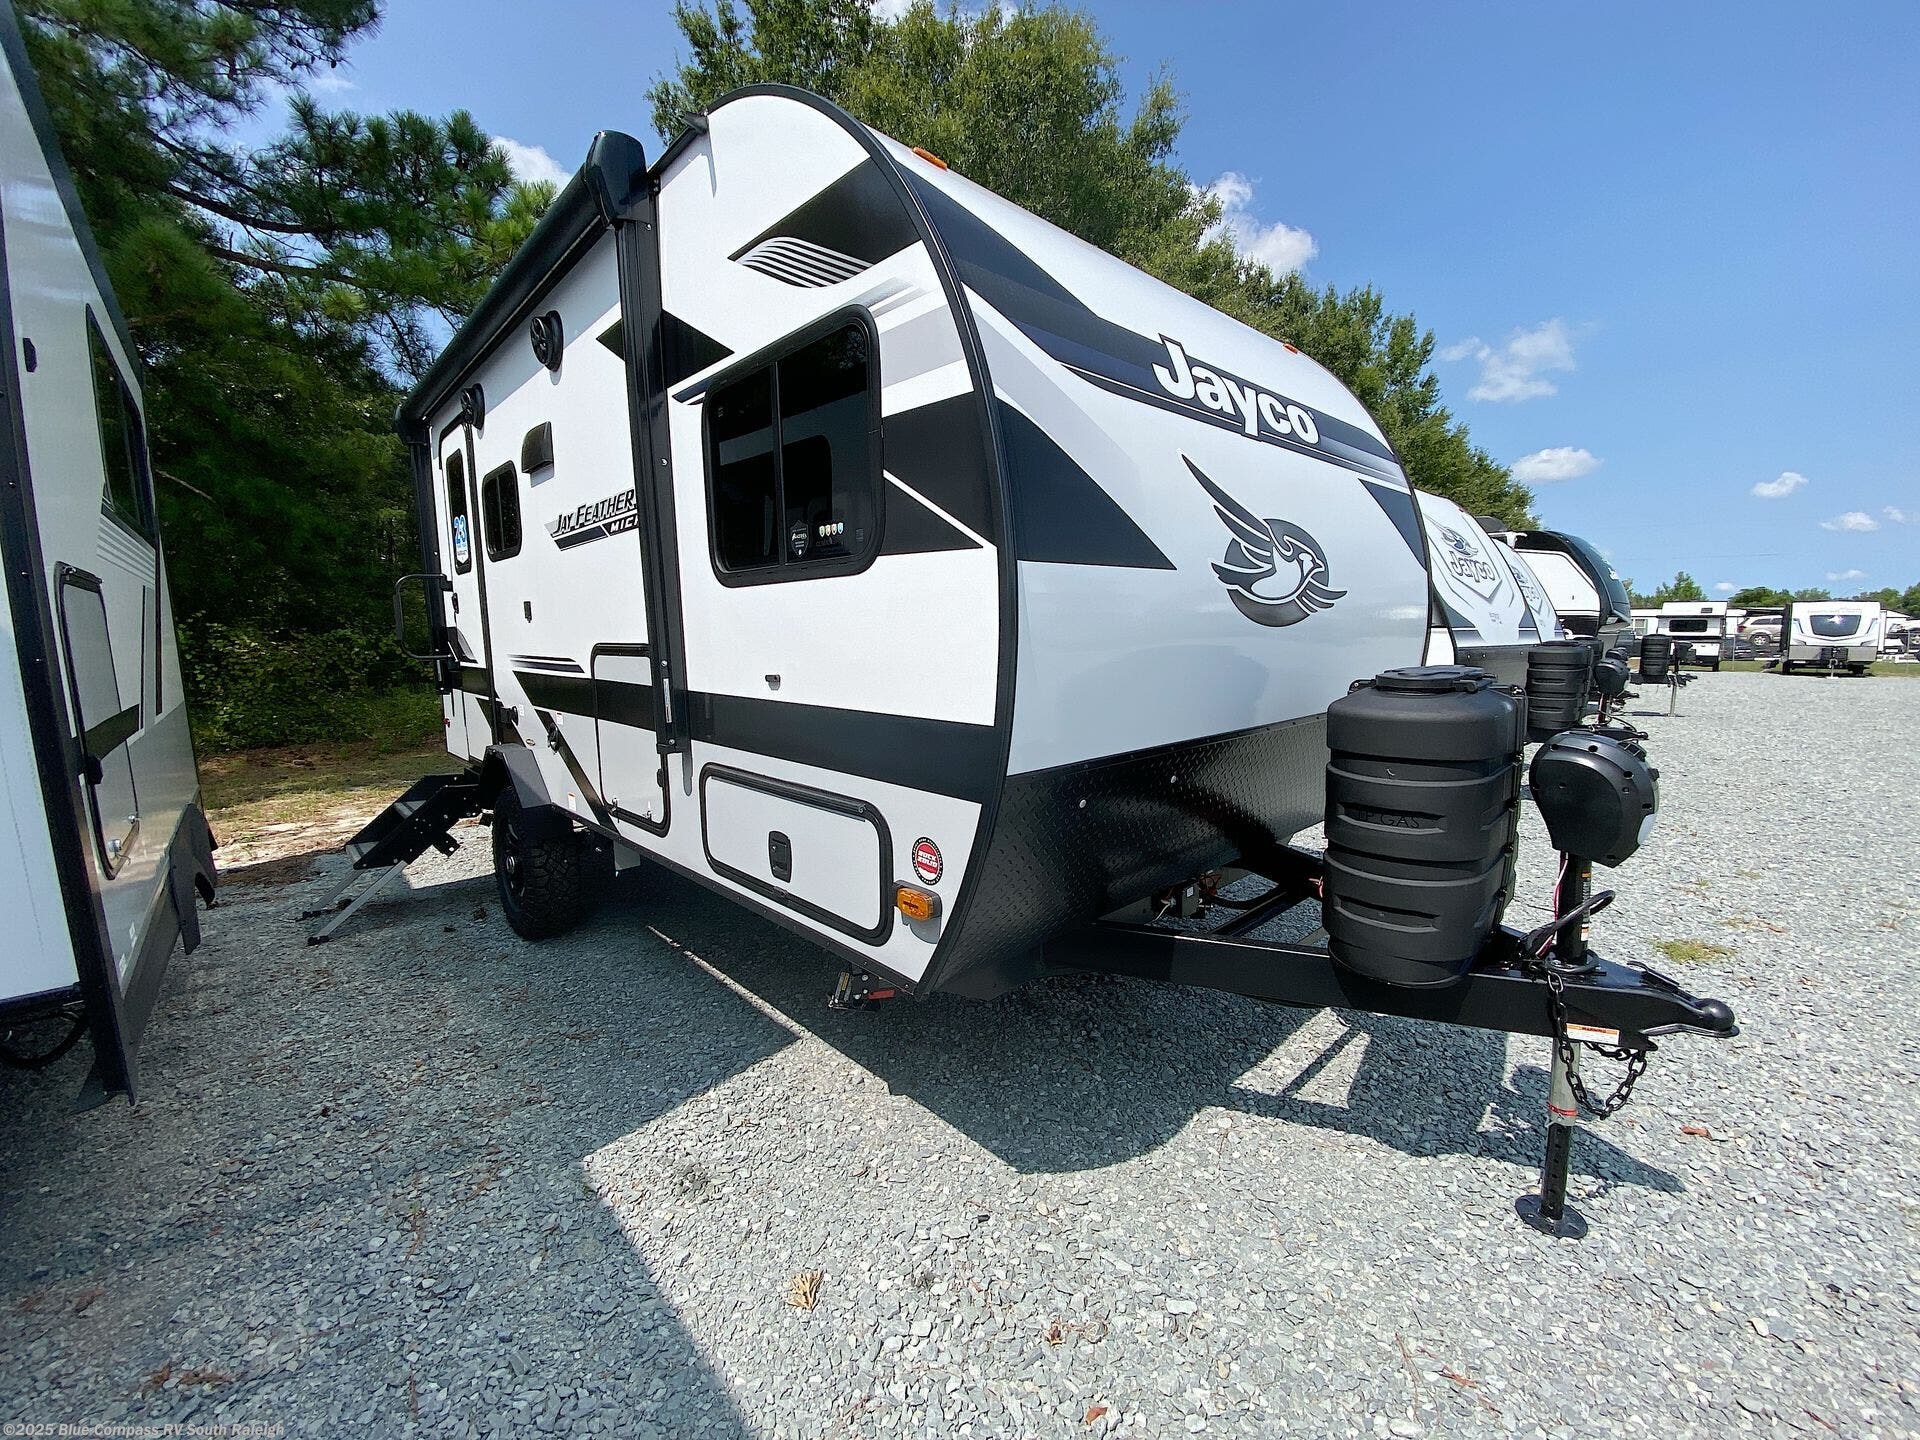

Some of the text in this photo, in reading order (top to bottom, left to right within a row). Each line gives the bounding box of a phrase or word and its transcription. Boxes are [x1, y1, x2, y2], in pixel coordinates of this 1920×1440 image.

[1151, 333, 1320, 444] Jayco
[551, 488, 635, 536] JAY FEATHER
[1448, 550, 1496, 583] Jayco
[1380, 812, 1420, 829] GAS
